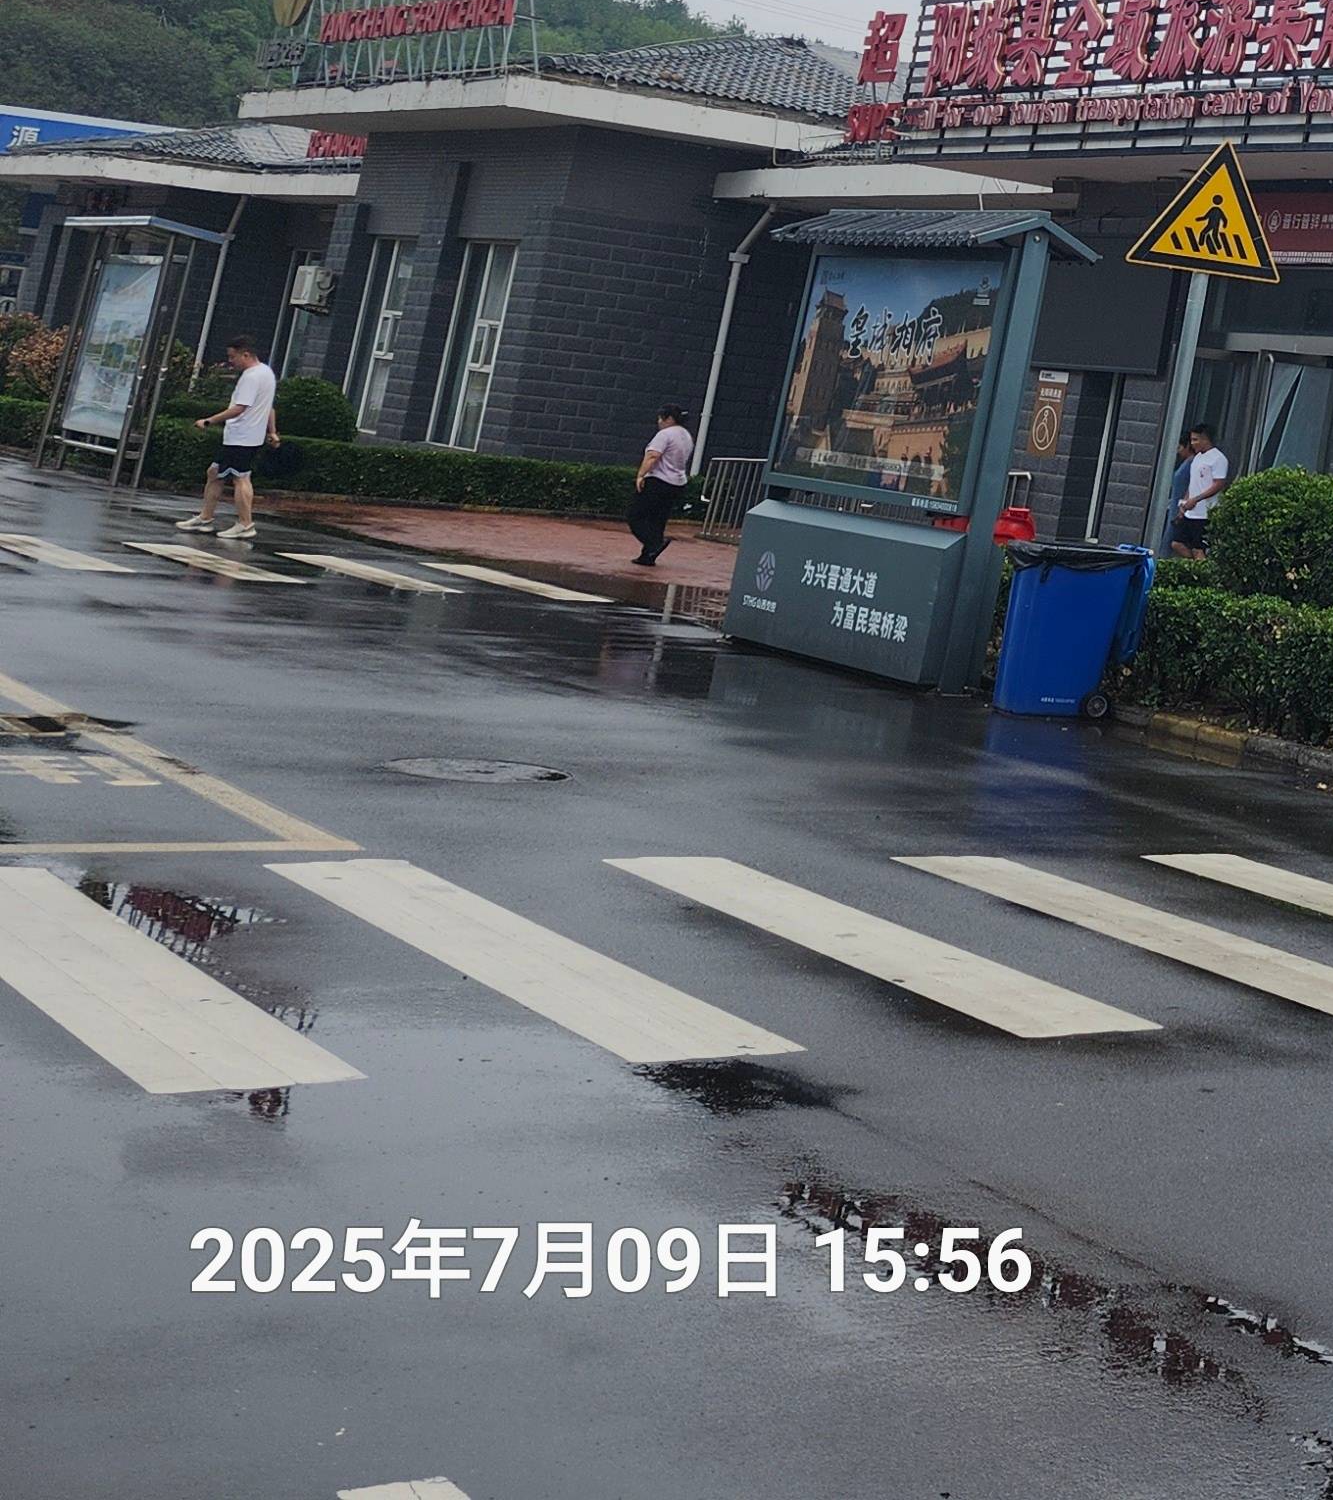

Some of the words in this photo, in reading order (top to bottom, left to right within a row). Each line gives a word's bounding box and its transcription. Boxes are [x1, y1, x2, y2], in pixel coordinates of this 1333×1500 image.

[319, 5, 407, 44] YANGCHENG
[858, 10, 908, 85] 超
[1009, 98, 1073, 126] tourism
[1075, 91, 1197, 125] transportation
[1201, 86, 1263, 117] centre
[1267, 80, 1296, 114] of
[800, 558, 878, 599] 为兴晋通大道
[830, 600, 909, 643] 为富民架桥梁
